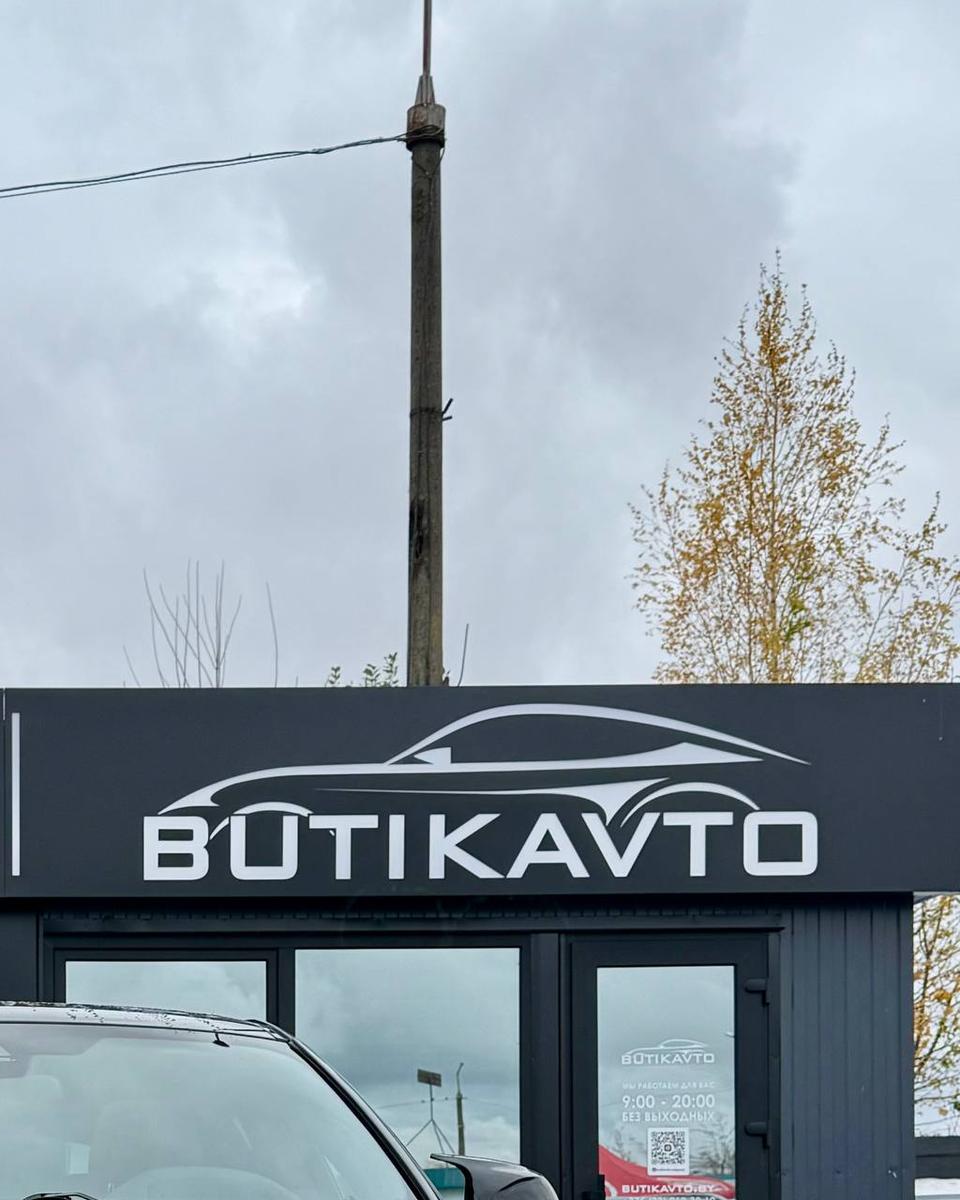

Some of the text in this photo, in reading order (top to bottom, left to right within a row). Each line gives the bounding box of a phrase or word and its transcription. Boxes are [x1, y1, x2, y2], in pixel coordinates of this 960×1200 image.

[142, 810, 819, 882] BUTIKAVTO
[621, 1053, 715, 1065] BUTIKAVTO
[622, 1095, 655, 1109] 9:00
[672, 1095, 715, 1108] 20:00
[622, 1111, 714, 1122] БЕЗ ВЫХОДНЫХ
[622, 1184, 714, 1194] BUTIKAVTO.BY
